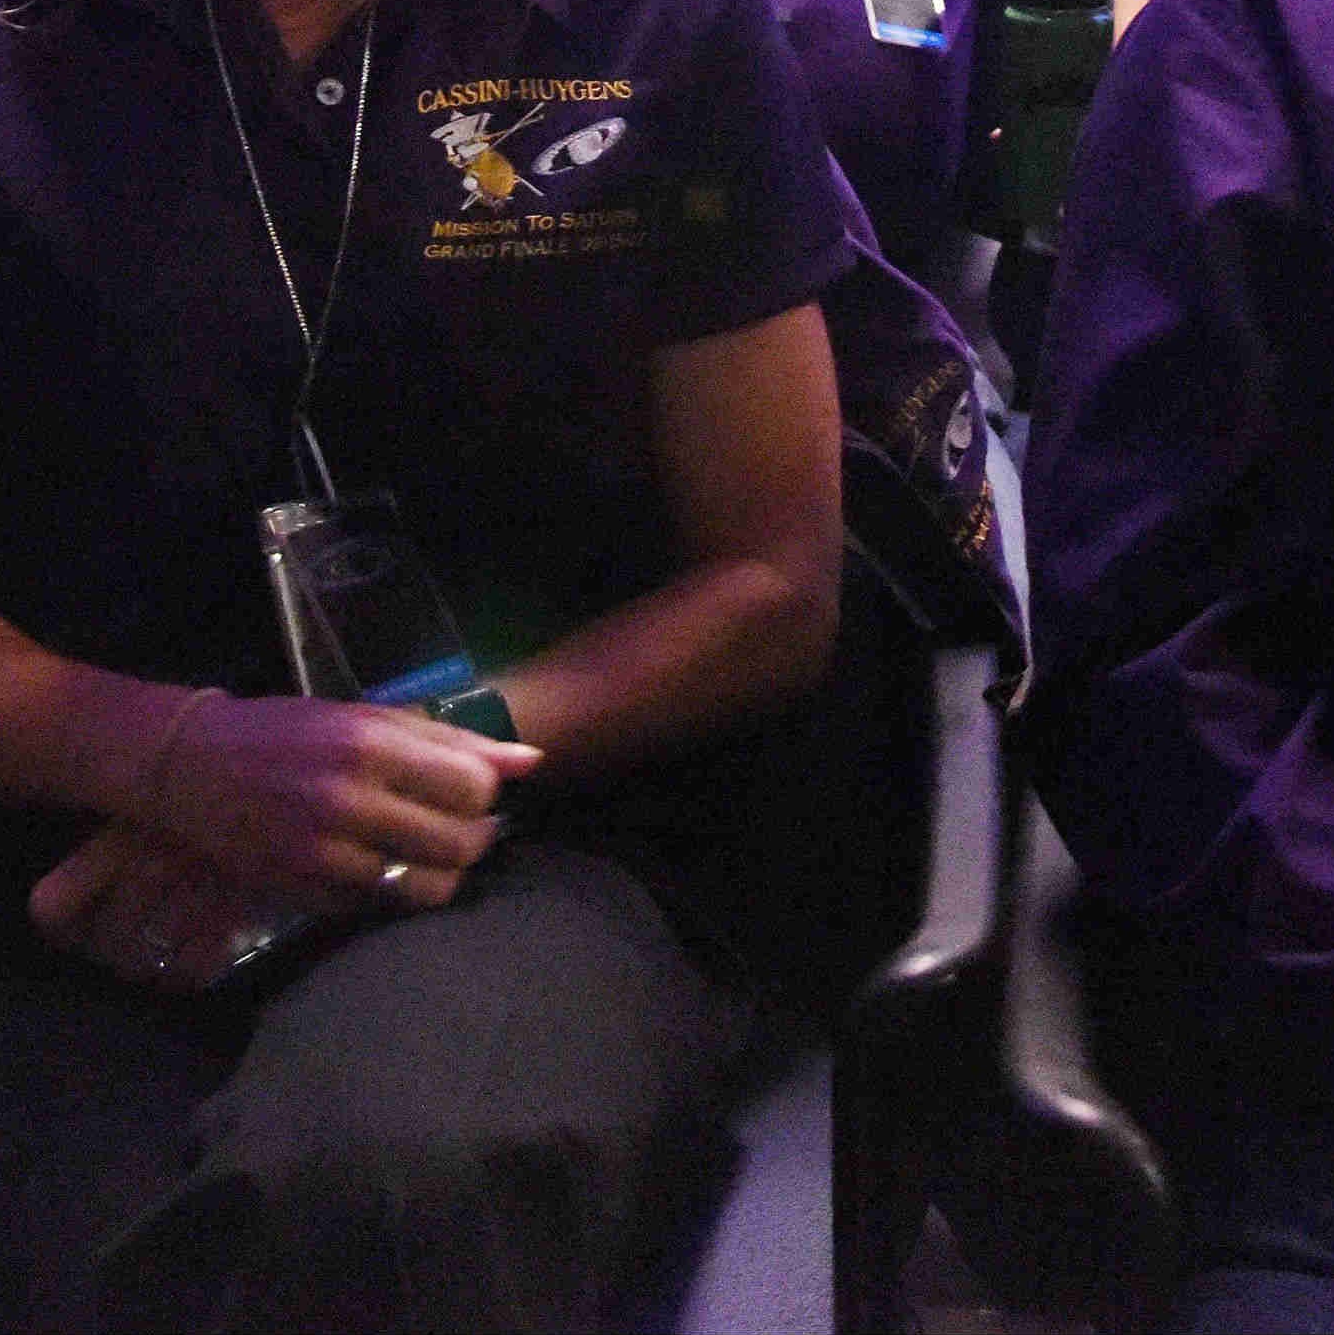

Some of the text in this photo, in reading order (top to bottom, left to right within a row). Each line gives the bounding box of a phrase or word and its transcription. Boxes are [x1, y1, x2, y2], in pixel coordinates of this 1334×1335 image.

[417, 79, 634, 114] CASSINI-HUYGENS
[431, 219, 519, 238] MISSION
[524, 214, 555, 231] TO
[423, 243, 496, 259] GRAND
[500, 239, 569, 257] FINALE
